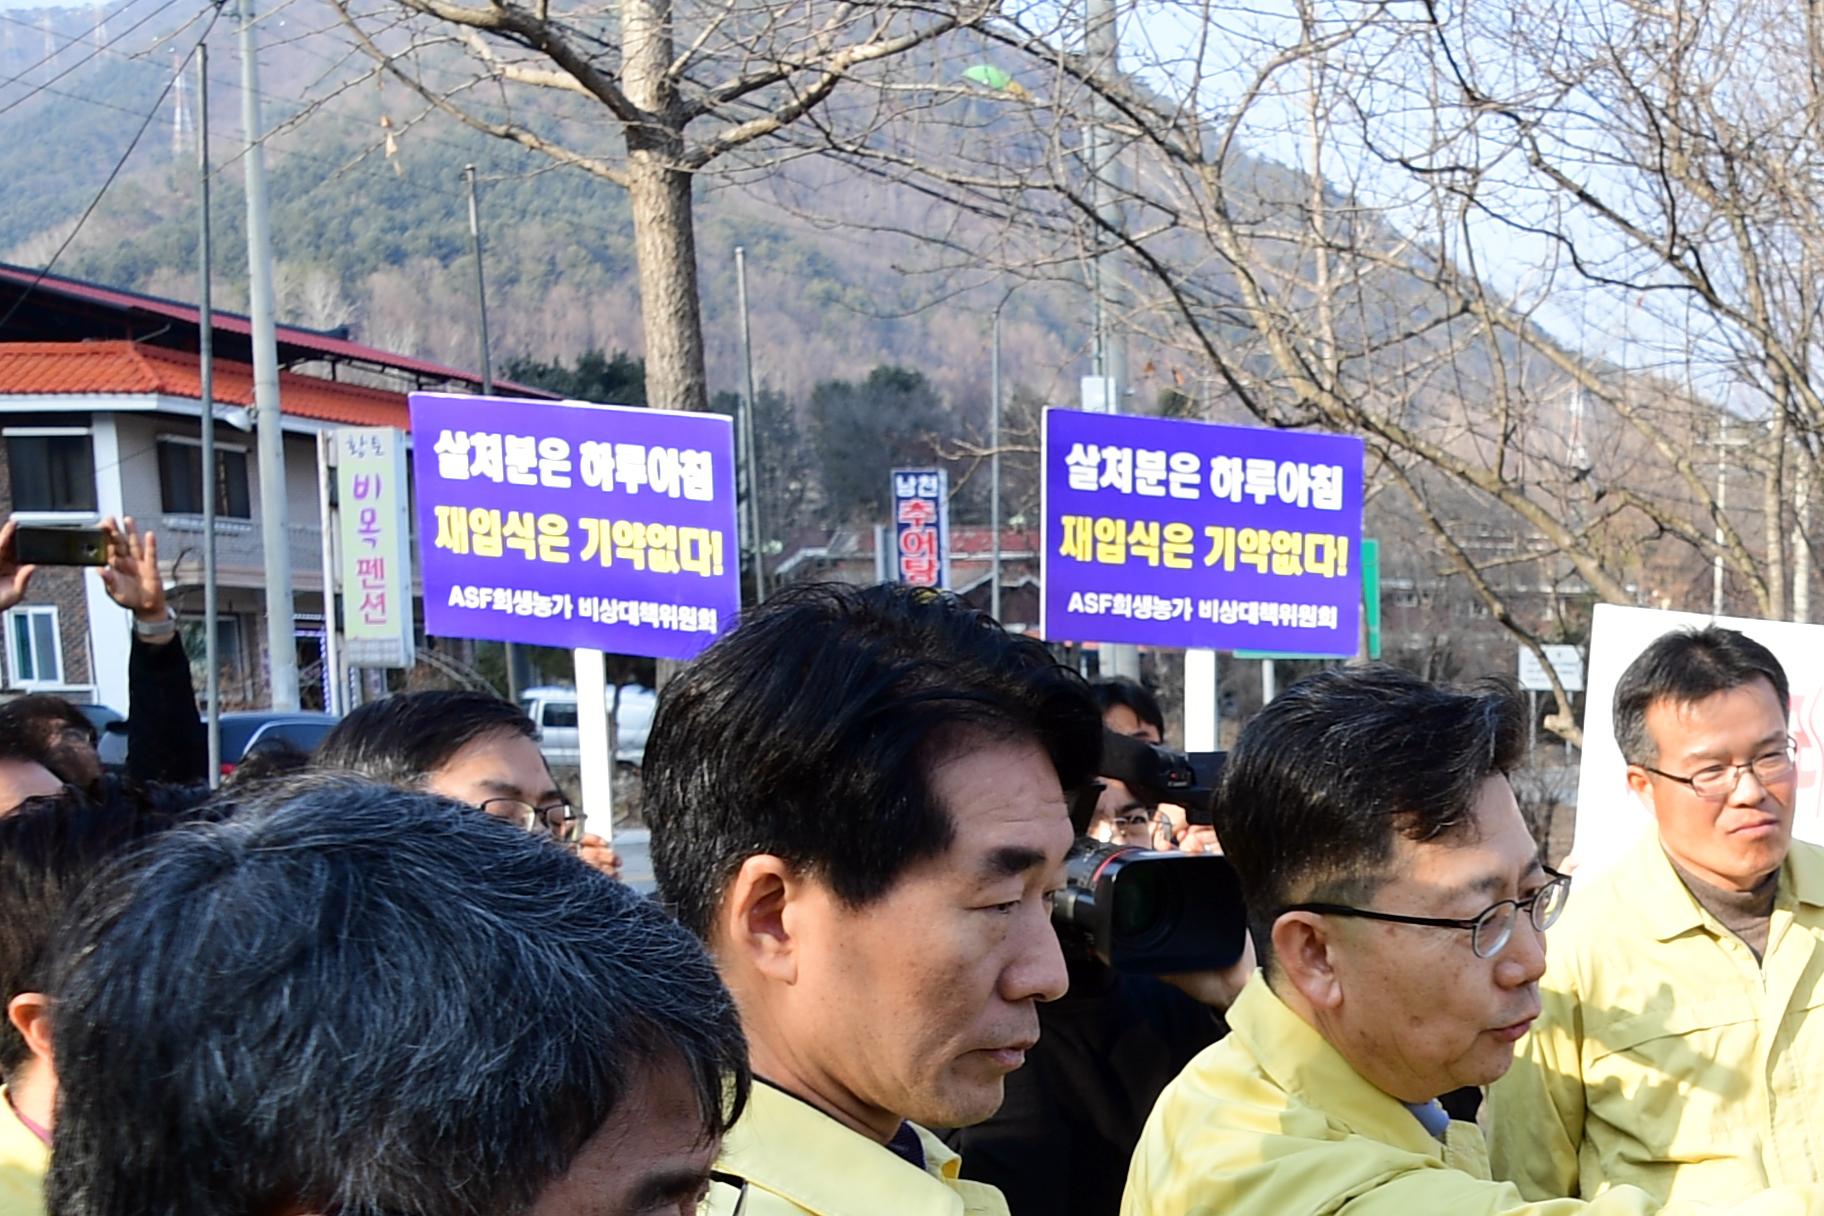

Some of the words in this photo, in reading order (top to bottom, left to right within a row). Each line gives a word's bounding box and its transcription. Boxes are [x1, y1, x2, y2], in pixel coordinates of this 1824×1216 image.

[433, 429, 572, 488] 살처분은
[579, 441, 713, 501] 하루아침
[1065, 443, 1200, 499] 살처분은
[1210, 455, 1343, 510] 하루아침
[434, 505, 570, 564] 재입식은
[578, 517, 724, 577] 기약없다!
[899, 499, 940, 586] 추어탕
[1059, 515, 1194, 569] 재입식은
[1203, 526, 1349, 578] 기약없다!
[448, 585, 574, 619] ASF희생농가
[578, 597, 718, 634] 비상대책위원회
[1067, 592, 1193, 622] ASF희생농가
[1198, 598, 1338, 629] 비상대책위원회
